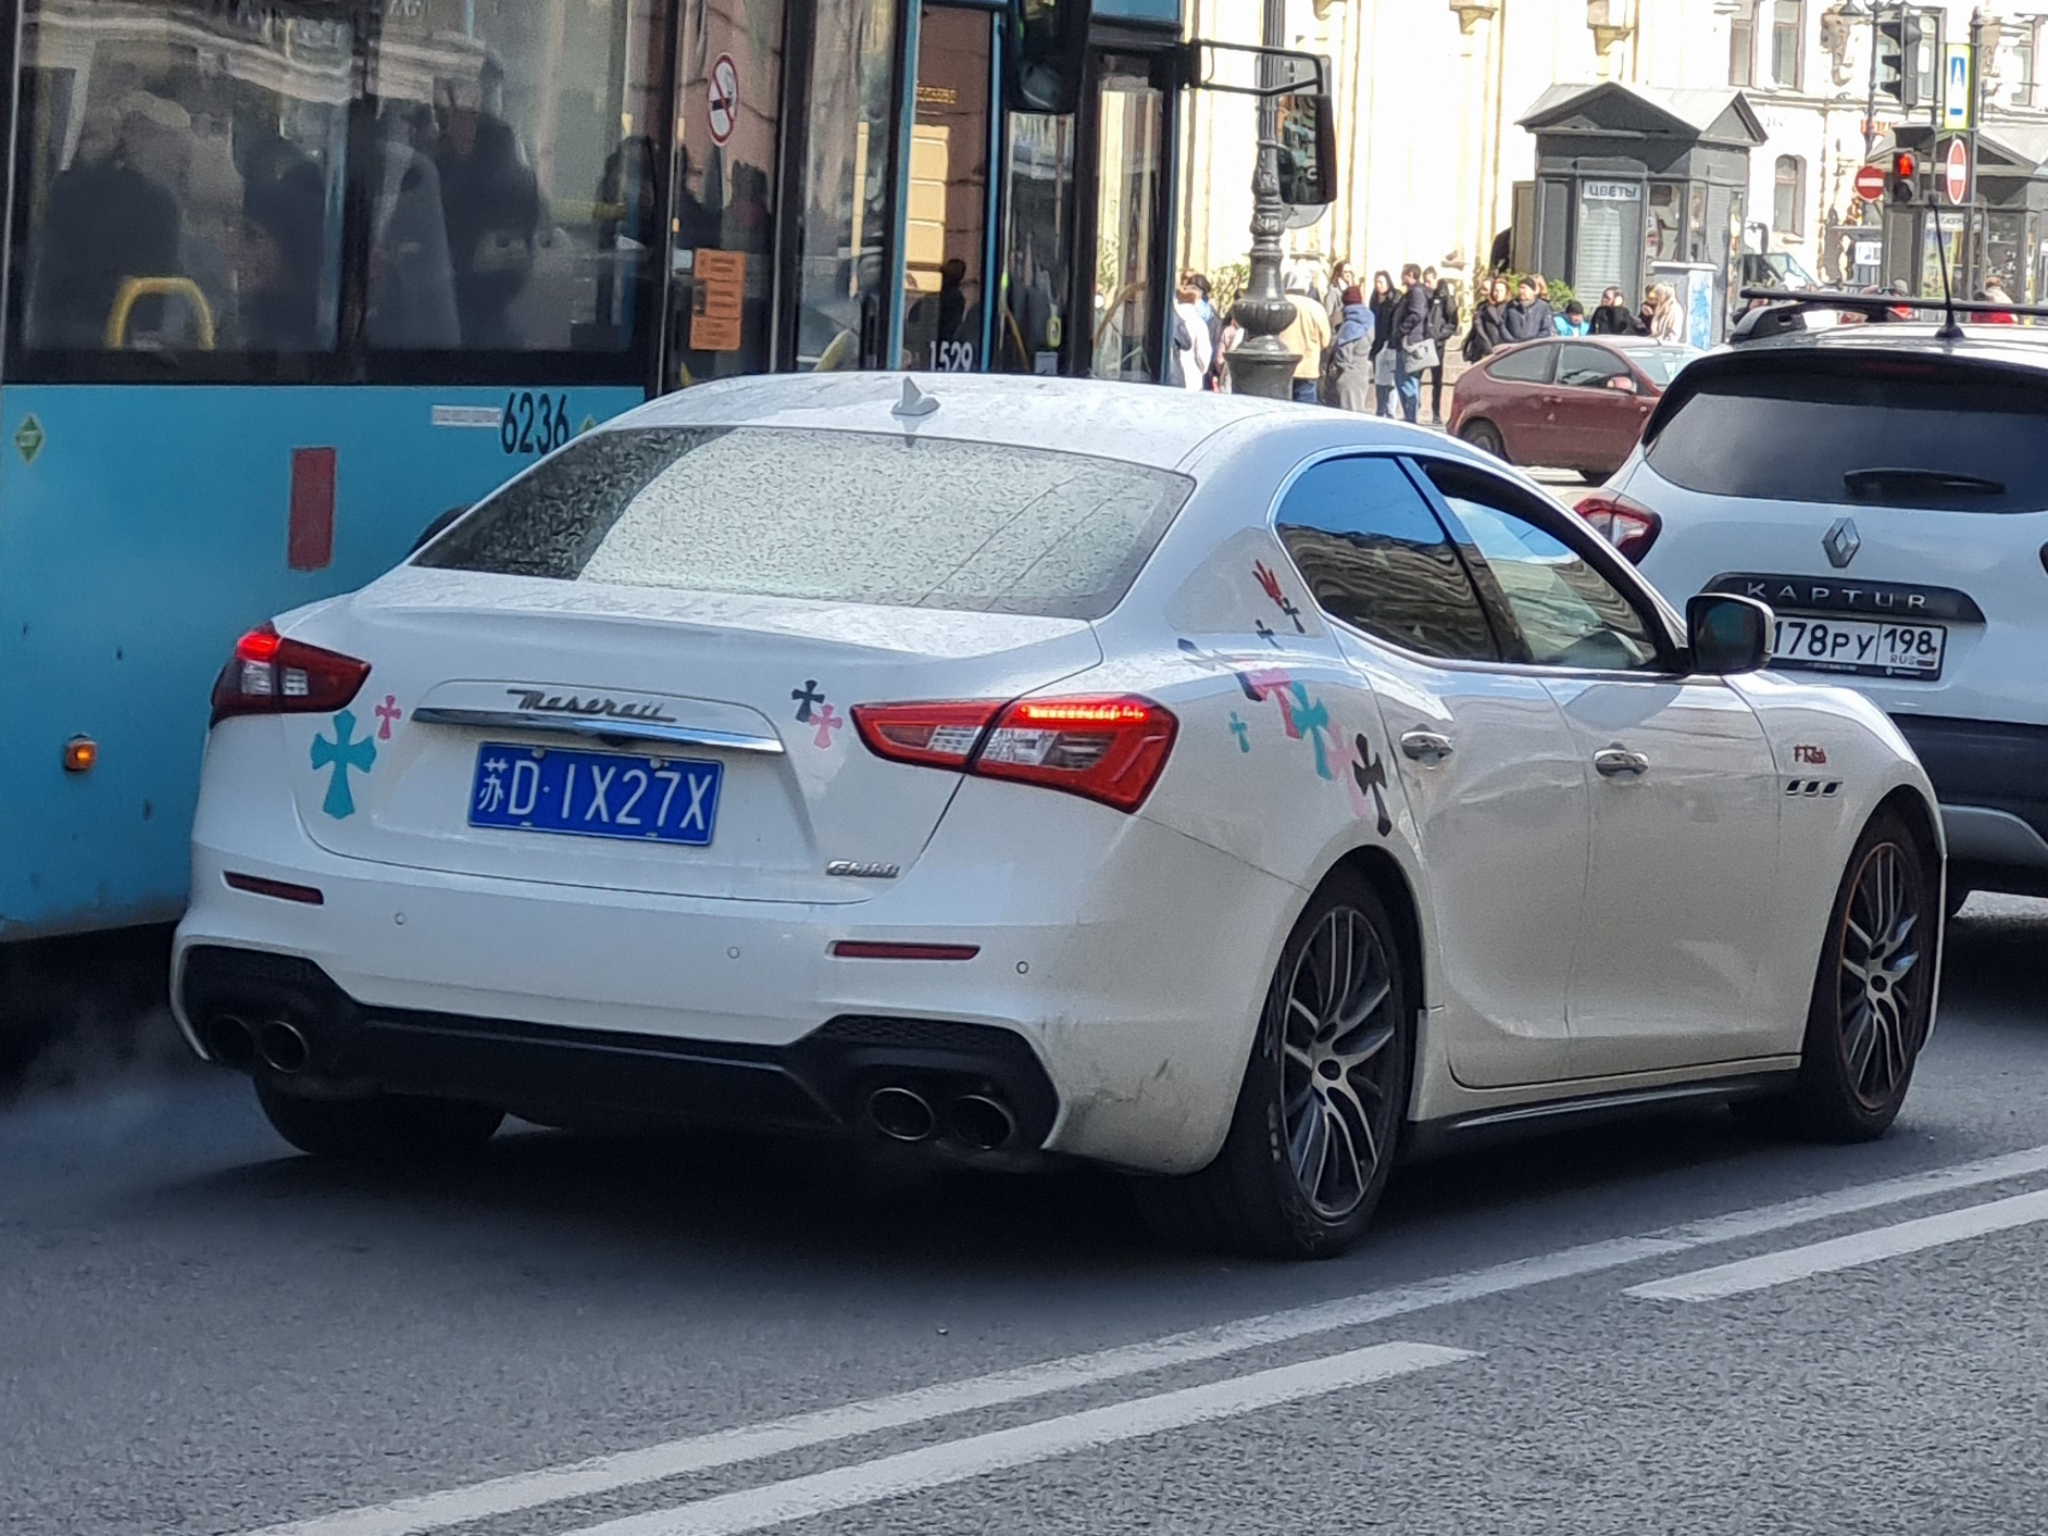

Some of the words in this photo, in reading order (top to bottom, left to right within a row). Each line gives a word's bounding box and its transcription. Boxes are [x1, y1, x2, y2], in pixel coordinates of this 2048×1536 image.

[1589, 184, 1637, 198] ЦВЕТЫ
[930, 340, 973, 372] 1529
[502, 392, 569, 455] 6236
[1747, 582, 1926, 609] KAPTUR
[1883, 628, 1933, 655] 198
[1889, 654, 1916, 665] RUS
[506, 688, 677, 723] Maserati
